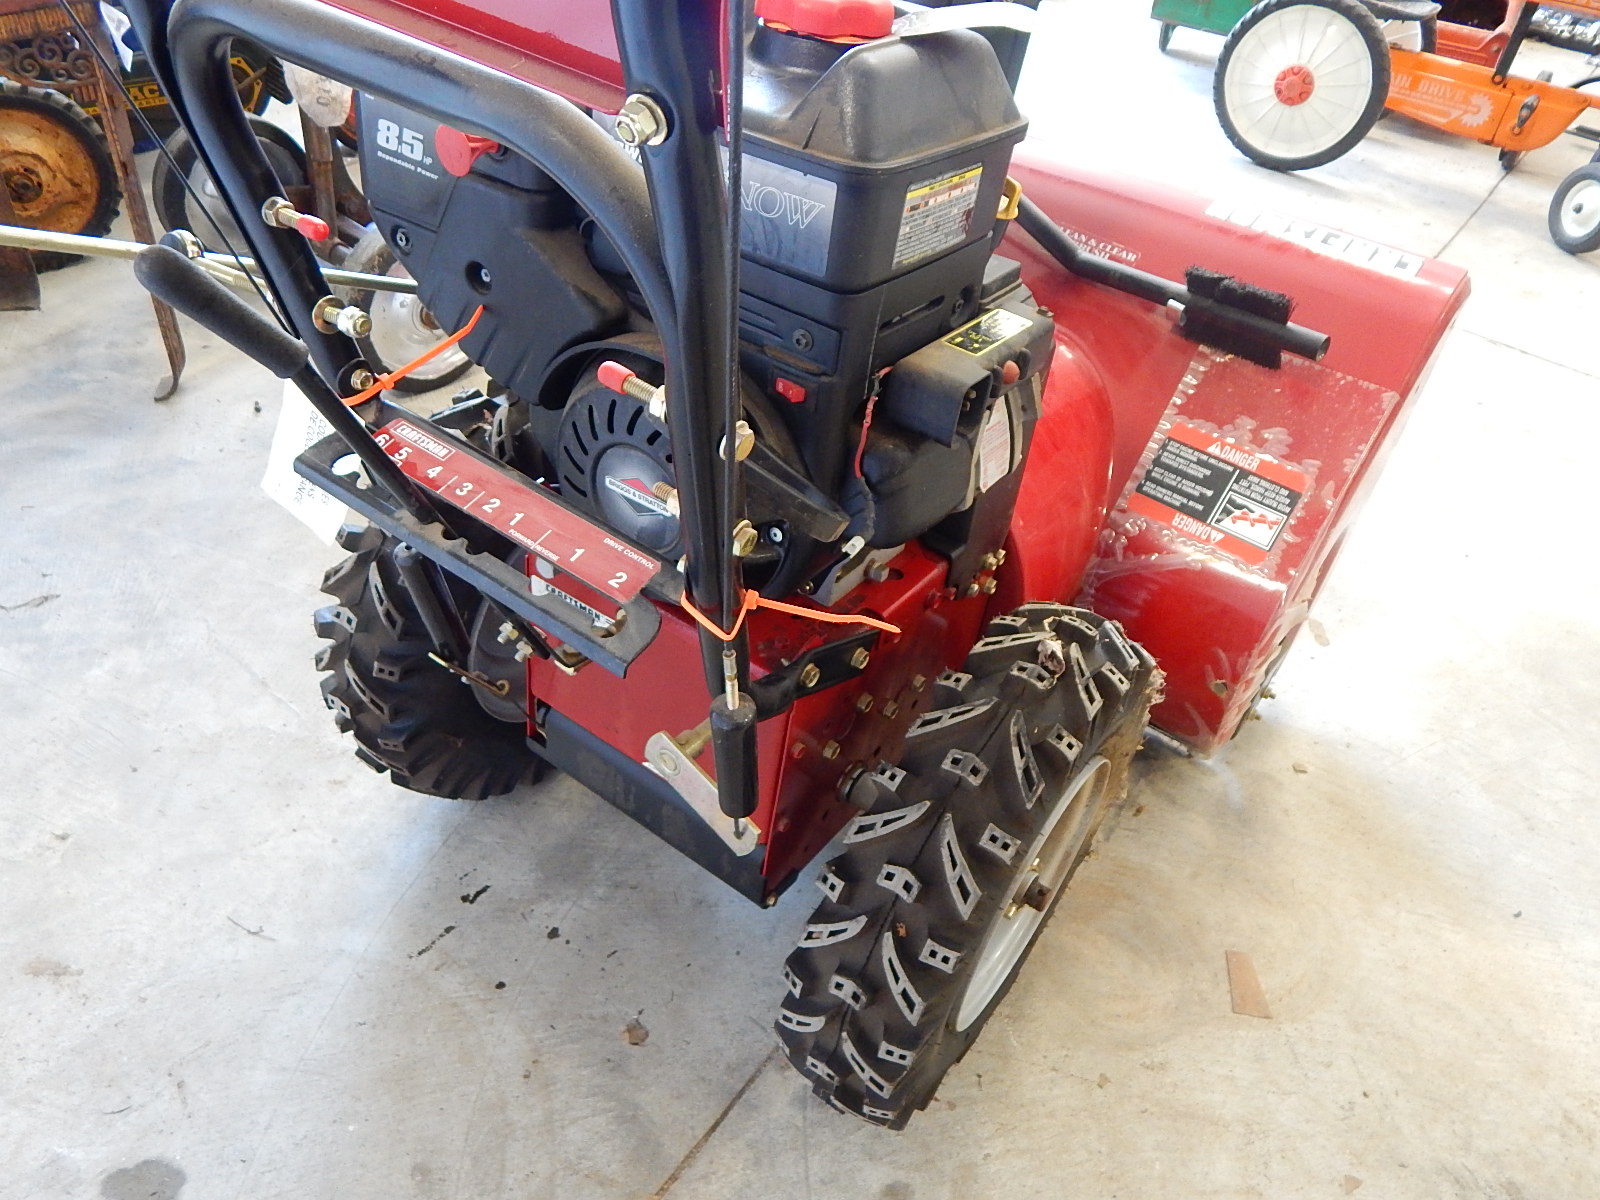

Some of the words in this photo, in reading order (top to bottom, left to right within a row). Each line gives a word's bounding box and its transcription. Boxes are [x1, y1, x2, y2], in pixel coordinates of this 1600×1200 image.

[1419, 79, 1466, 101] DRIVE
[377, 118, 424, 161] 8.5
[377, 150, 416, 172] Dependable
[416, 166, 439, 180] Power
[1060, 226, 1088, 242] LEAN
[1099, 242, 1137, 262] CLEAR
[396, 424, 450, 458] CRAFTSMAN
[394, 446, 412, 460] 5
[1220, 445, 1261, 472] DANGER
[426, 466, 444, 478] 4
[456, 482, 474, 496] 3
[608, 480, 632, 495] BRIGGS
[638, 494, 669, 513] STRATTON
[482, 498, 501, 513] 2
[510, 512, 524, 526] 1
[1172, 512, 1211, 540] DANGER
[508, 528, 534, 546] FORWARD
[534, 544, 560, 562] REVERSE
[570, 548, 585, 562] 1
[602, 537, 624, 552] DRIVE
[623, 549, 654, 570] CONTROL
[608, 572, 628, 588] 2
